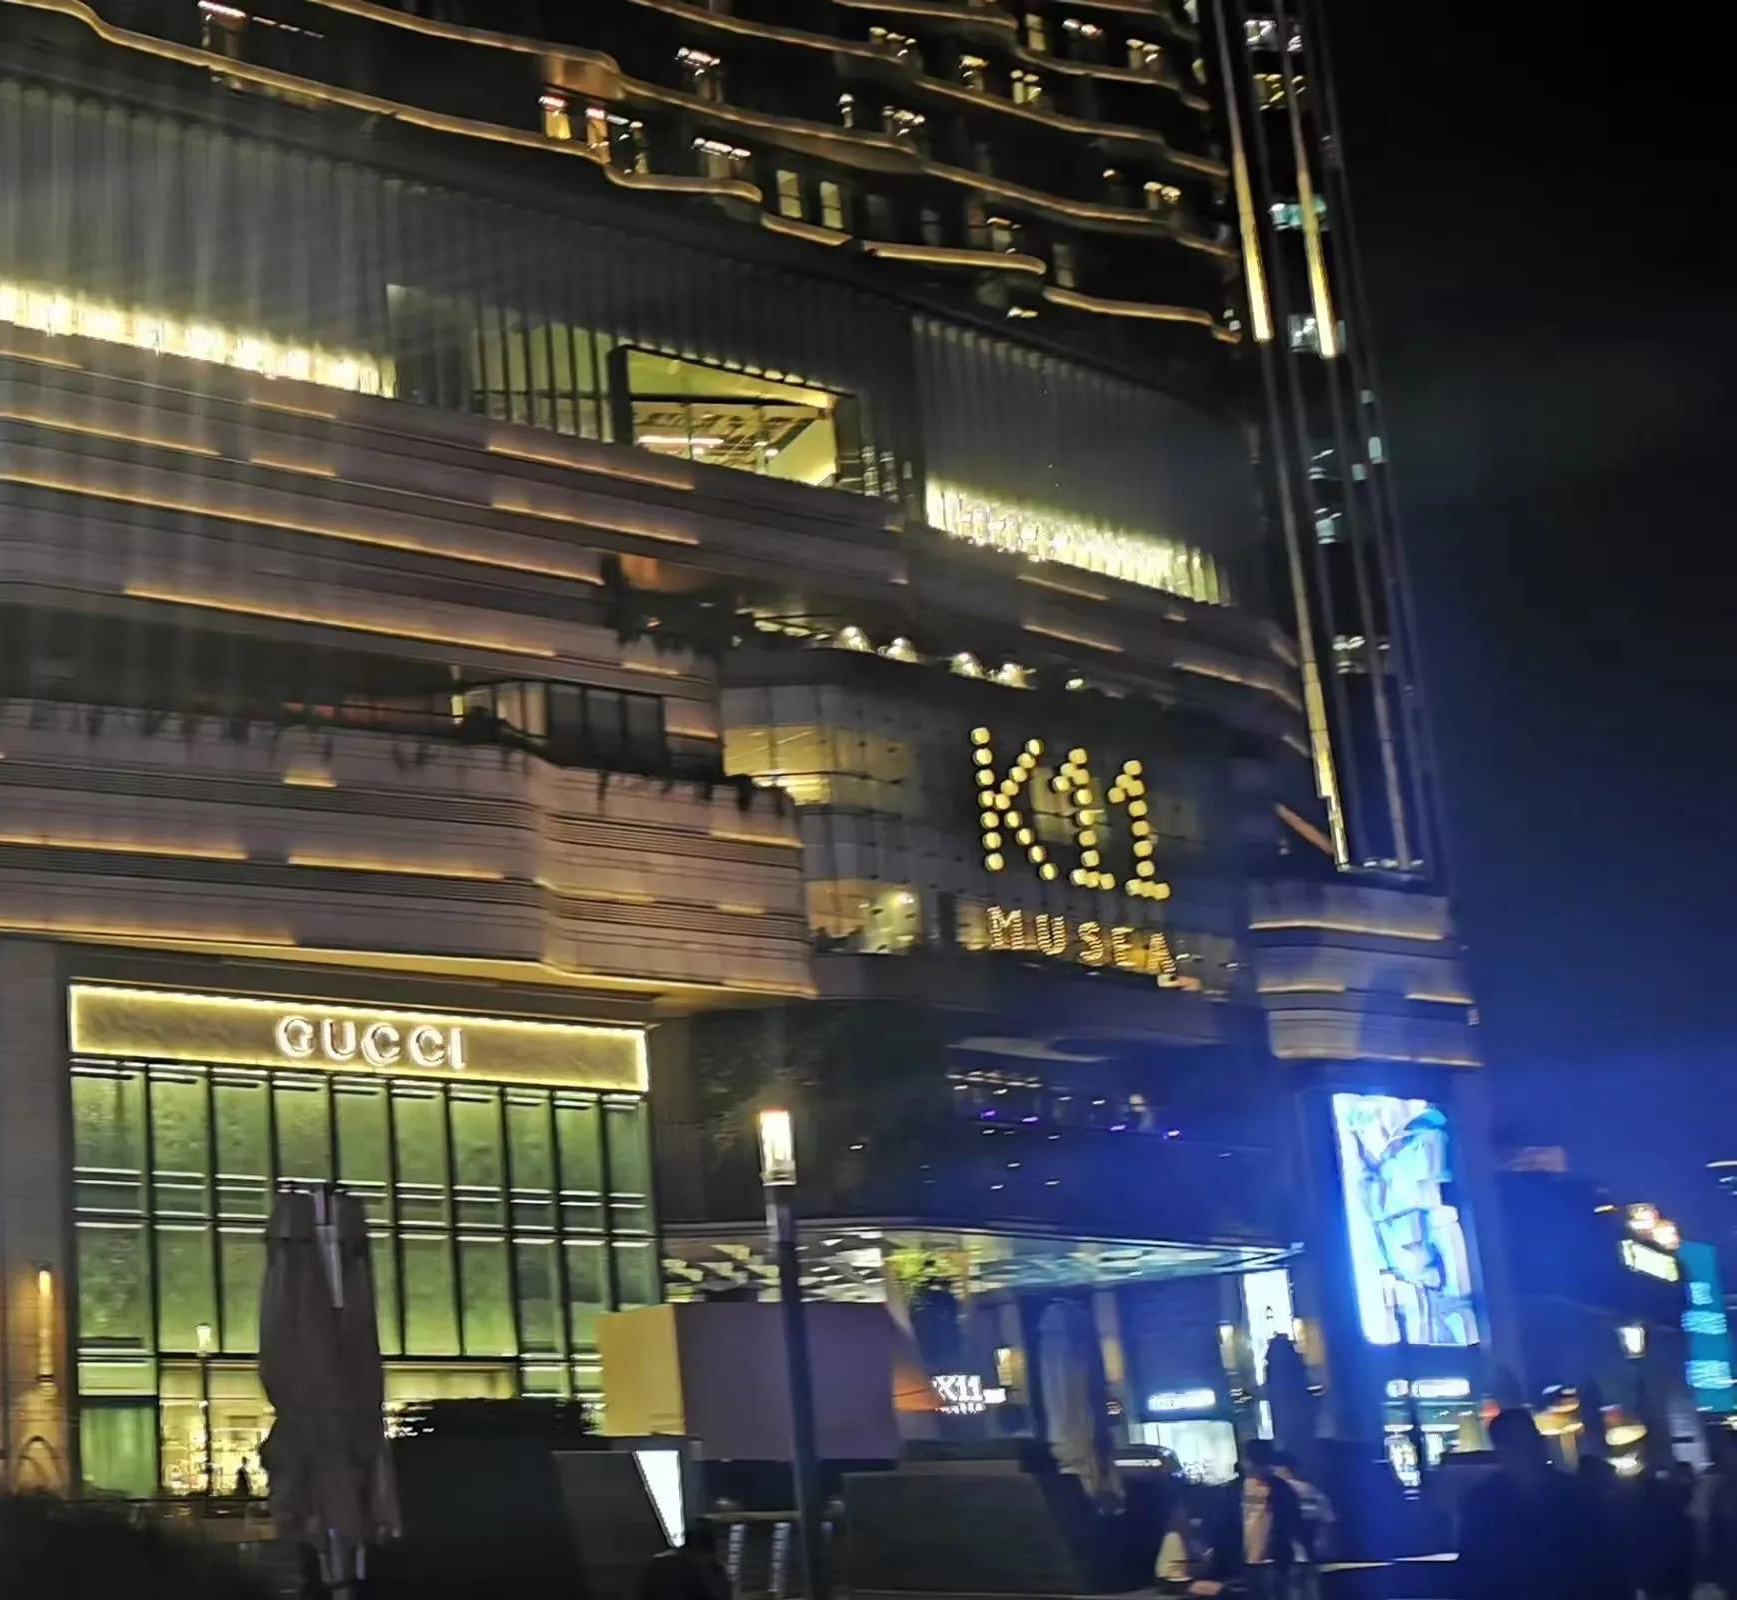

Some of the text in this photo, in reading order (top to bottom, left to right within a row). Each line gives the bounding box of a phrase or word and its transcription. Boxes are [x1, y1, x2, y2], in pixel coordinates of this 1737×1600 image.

[969, 726, 1171, 900] K11
[986, 905, 1177, 978] MUSEA
[276, 1014, 467, 1071] GUCCI
